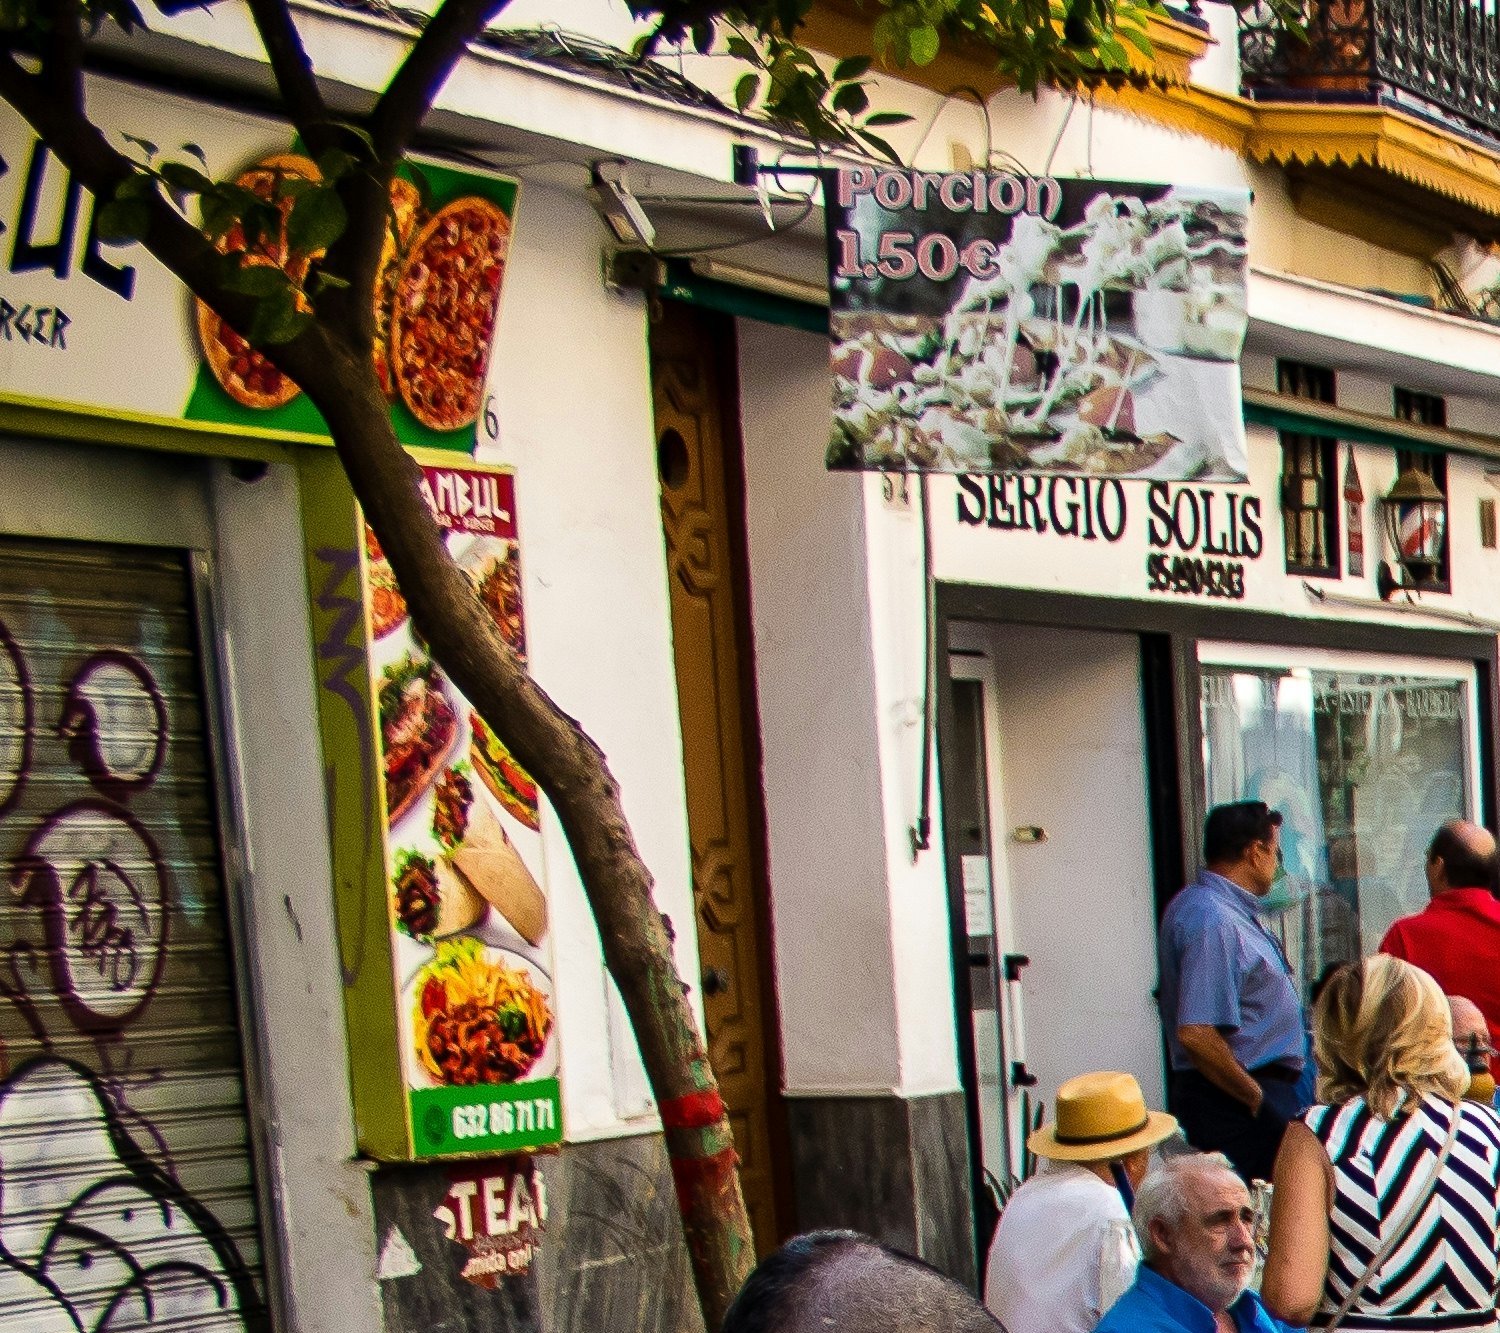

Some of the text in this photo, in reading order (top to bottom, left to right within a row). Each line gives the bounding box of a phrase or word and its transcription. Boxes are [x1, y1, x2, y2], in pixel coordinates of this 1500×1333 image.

[837, 229, 1000, 281] 1.50€
[397, 472, 511, 524] AMBUL
[954, 473, 1127, 542] SERGIO
[1147, 481, 1263, 559] SOLIS
